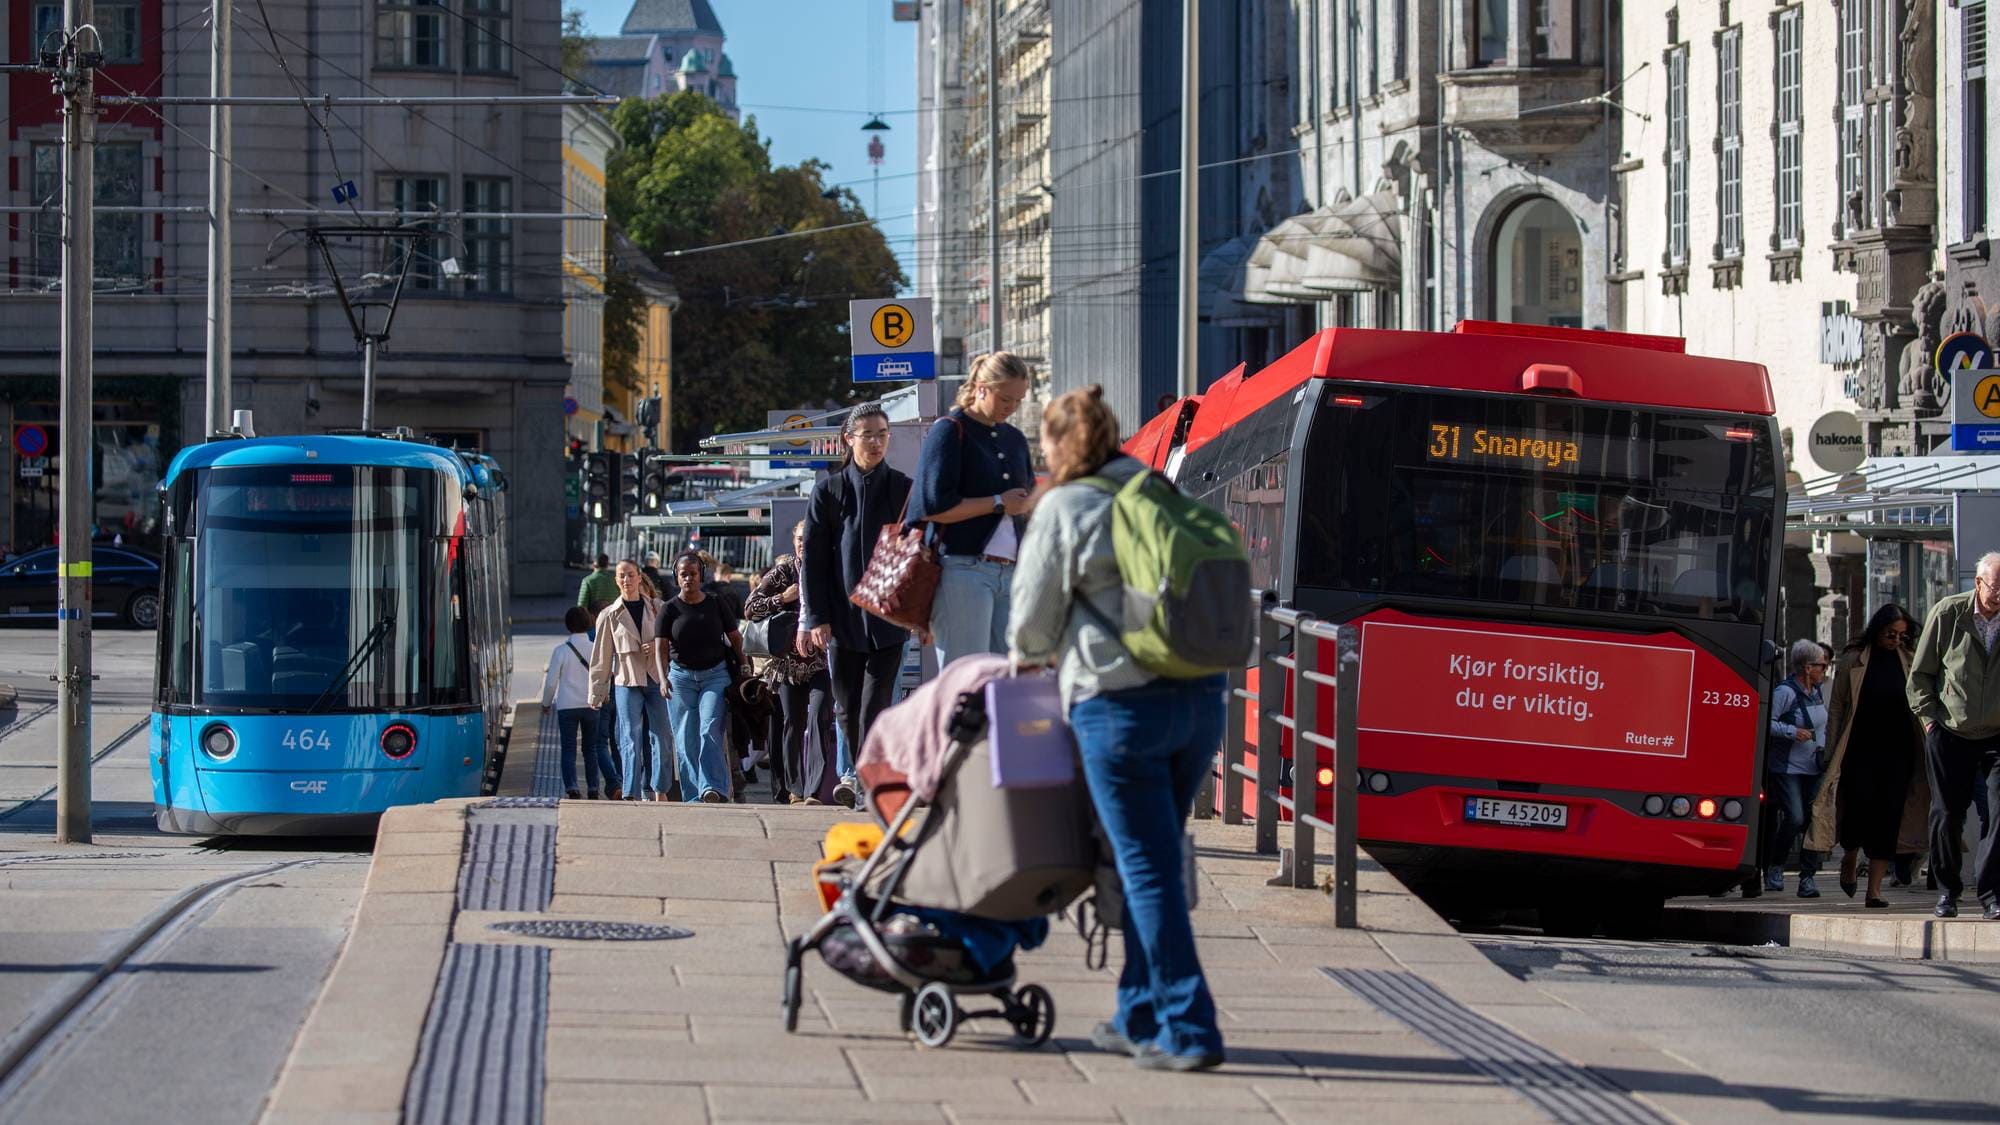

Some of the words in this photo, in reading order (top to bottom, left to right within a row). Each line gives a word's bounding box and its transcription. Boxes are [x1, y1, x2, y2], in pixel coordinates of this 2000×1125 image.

[884, 312, 903, 339] B
[1983, 383, 2000, 410] A
[1430, 424, 1461, 459] 31
[1472, 428, 1578, 467] Snarøya
[1816, 433, 1862, 445] hakone
[1449, 654, 1496, 679] Kjør
[1503, 659, 1605, 691] forsiktig,
[1456, 688, 1484, 709] du
[1492, 692, 1516, 711] er
[1523, 694, 1594, 722] viktig.
[1702, 691, 1720, 705] 23
[1724, 692, 1750, 708] 283
[282, 729, 331, 750] 464
[1625, 732, 1675, 747] Ruter#
[290, 781, 328, 794] CAF
[1481, 802, 1500, 818] EF
[1508, 804, 1561, 823] 45209
